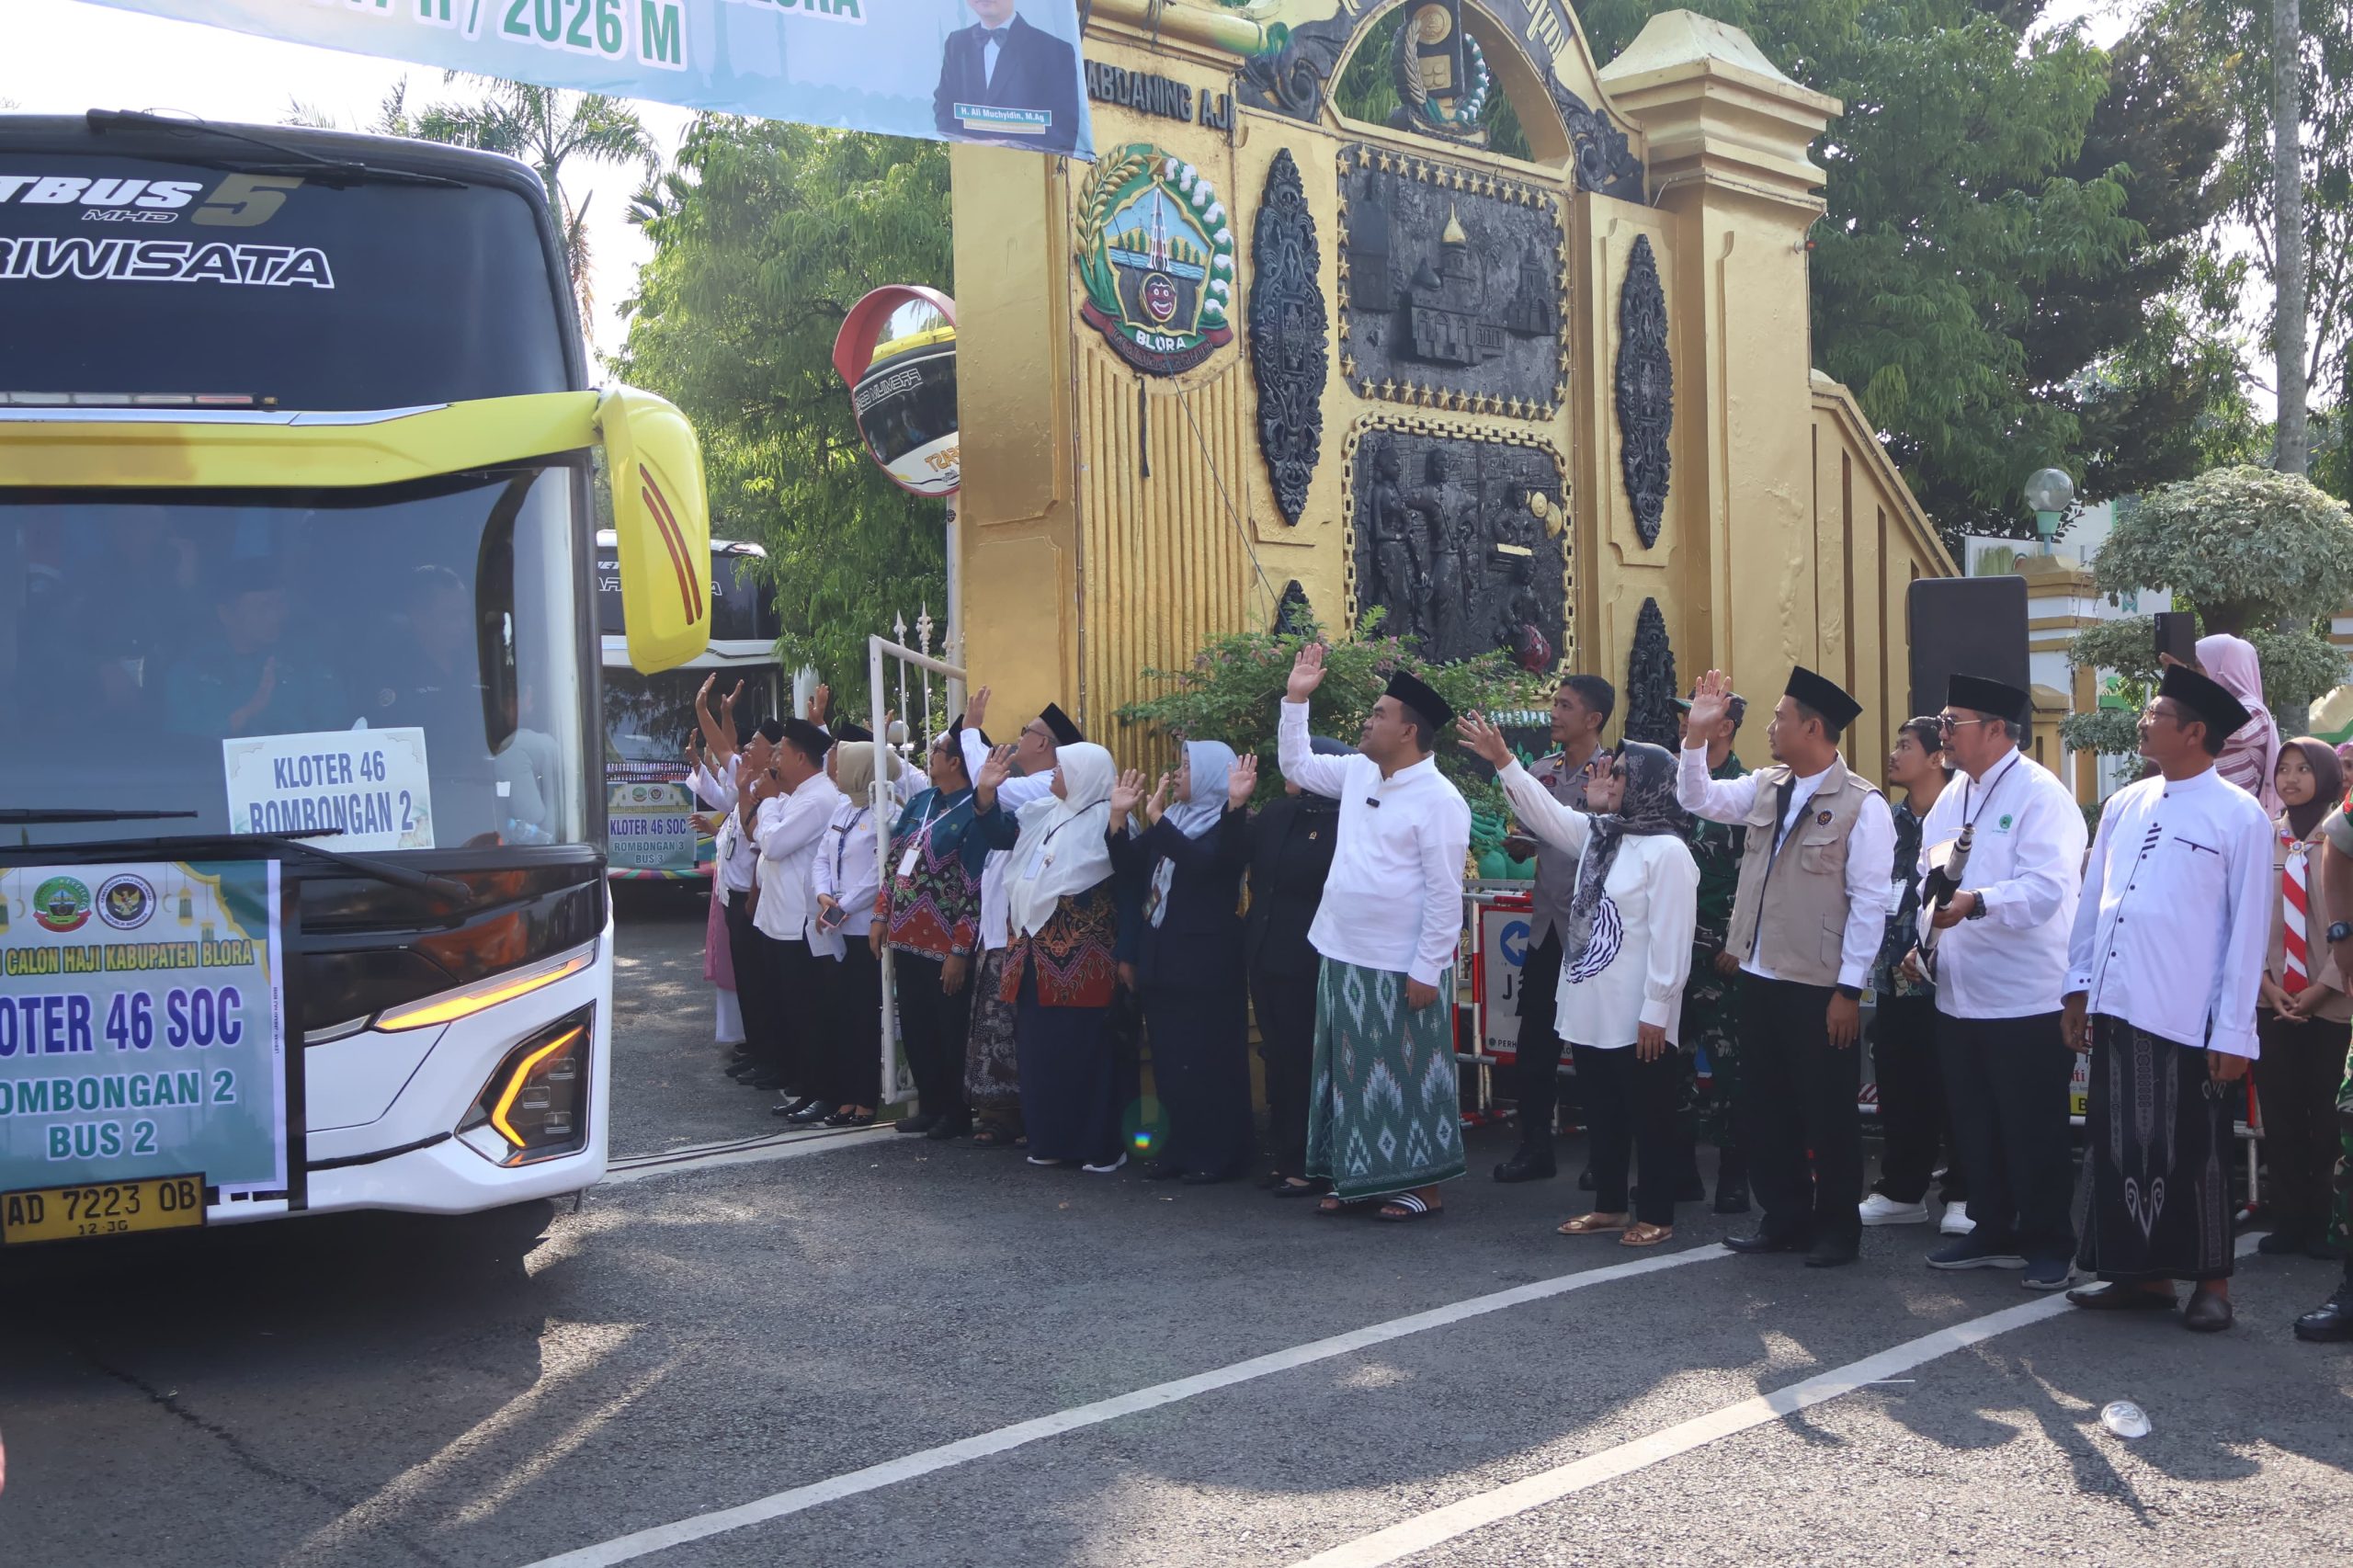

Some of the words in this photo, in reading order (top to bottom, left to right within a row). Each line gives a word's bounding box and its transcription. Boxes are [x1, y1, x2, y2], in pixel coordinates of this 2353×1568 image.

[504, 0, 623, 53] 2026
[642, 0, 681, 65] M
[1200, 88, 1236, 131] AJI
[82, 210, 179, 223] MHD
[191, 173, 306, 227] 5
[1135, 329, 1187, 351] BLORA
[274, 752, 354, 790] KLOTER
[360, 750, 386, 782] 46
[249, 791, 393, 835] ROMBONGAN
[399, 790, 414, 831] 2
[610, 819, 648, 835] KLOTER
[651, 819, 664, 835] 46
[666, 818, 687, 835] SOC
[614, 840, 676, 852] ROMBONGAN
[678, 841, 685, 850] 3
[635, 854, 655, 863] BUS
[6, 947, 61, 975] CALON
[63, 945, 101, 973] HAJI
[105, 941, 199, 971] KABUPATEN
[202, 939, 254, 967] BLORA
[106, 992, 153, 1050] 46
[167, 986, 242, 1048] SOC
[213, 1071, 234, 1102] 2
[50, 1122, 120, 1158] BUS
[134, 1121, 155, 1153] 2
[7, 1194, 44, 1226] AD
[63, 1184, 141, 1221] 7223
